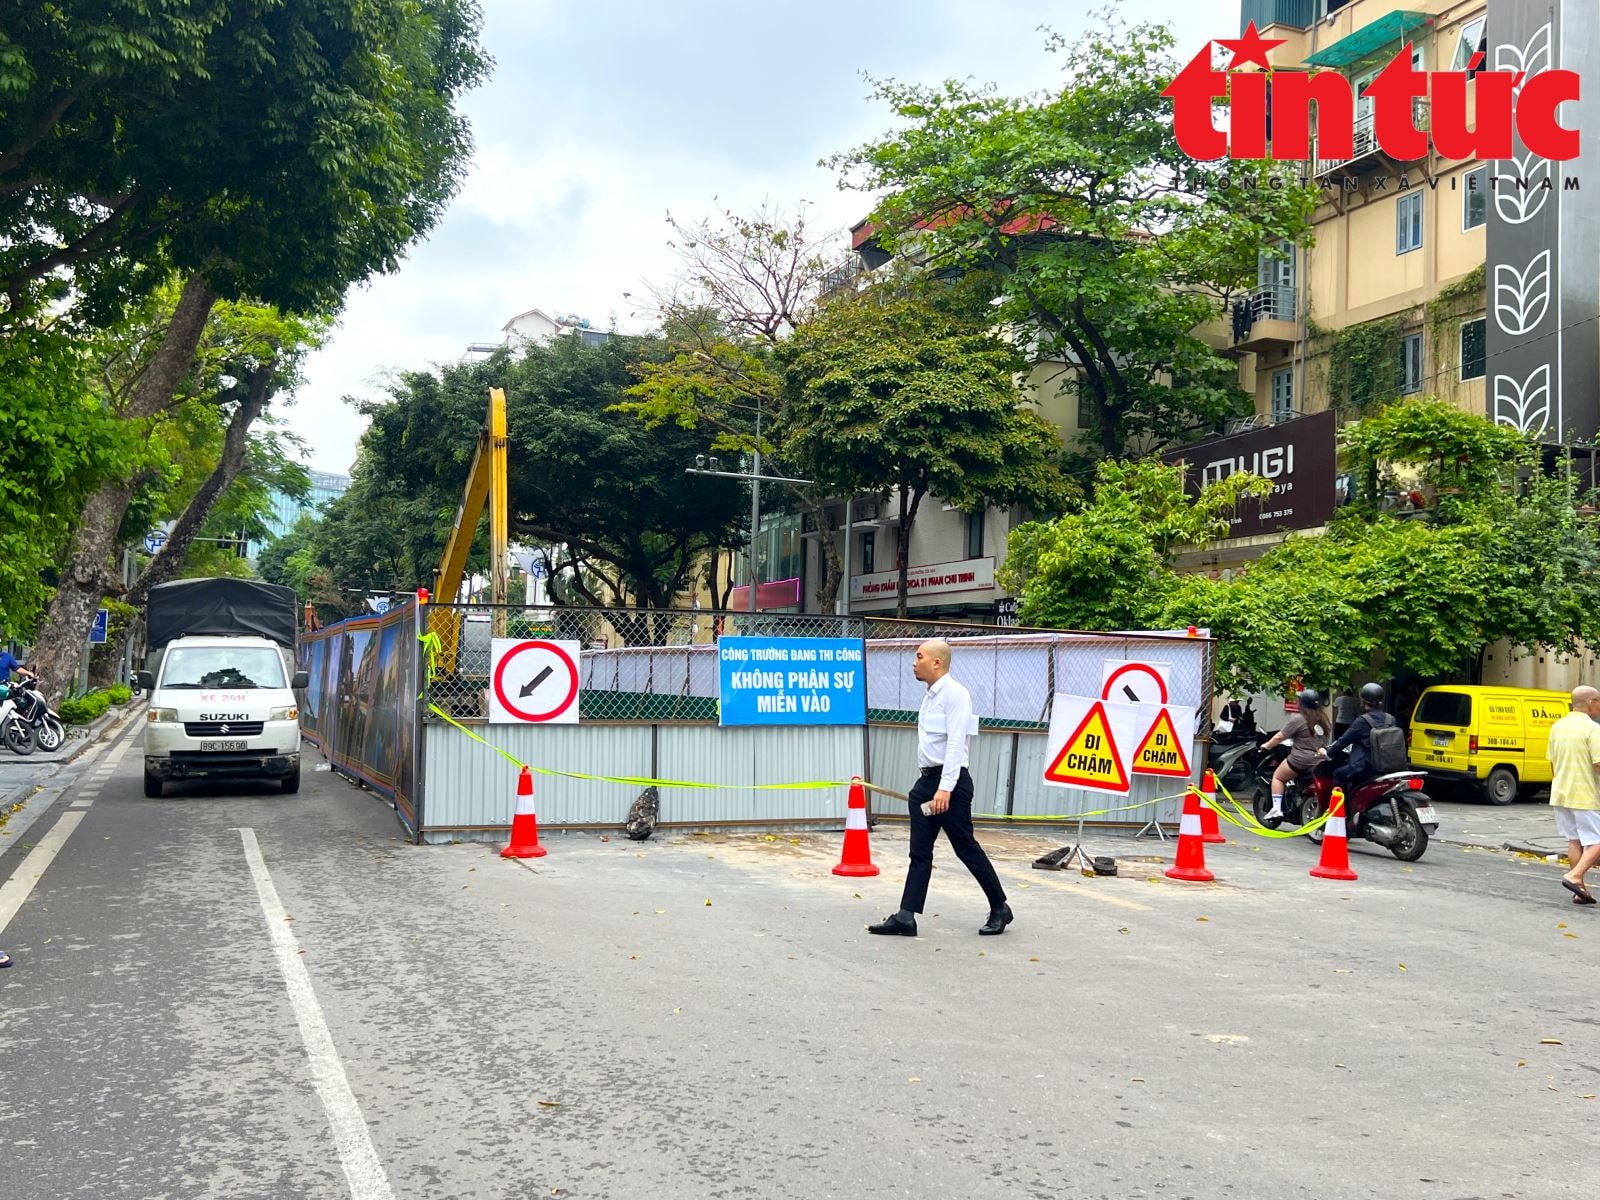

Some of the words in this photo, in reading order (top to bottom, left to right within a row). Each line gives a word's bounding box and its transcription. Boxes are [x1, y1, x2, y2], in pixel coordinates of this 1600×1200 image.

[722, 646, 748, 661] CÔNG
[751, 646, 788, 661] TRƯỜNG
[790, 649, 817, 661] ĐANG
[819, 649, 833, 661] THI
[836, 647, 861, 661] CÔNG
[731, 668, 784, 689] KHÔNG
[834, 671, 855, 692] SỰ
[201, 694, 216, 702] XE
[757, 690, 797, 713] MIỄN
[801, 690, 830, 713] VÀO
[200, 713, 249, 721] SUZUKI
[1084, 733, 1101, 750] ĐI
[1155, 733, 1167, 746] ĐI
[1067, 753, 1112, 775] CHẬM
[1143, 749, 1177, 766] CHẬM
